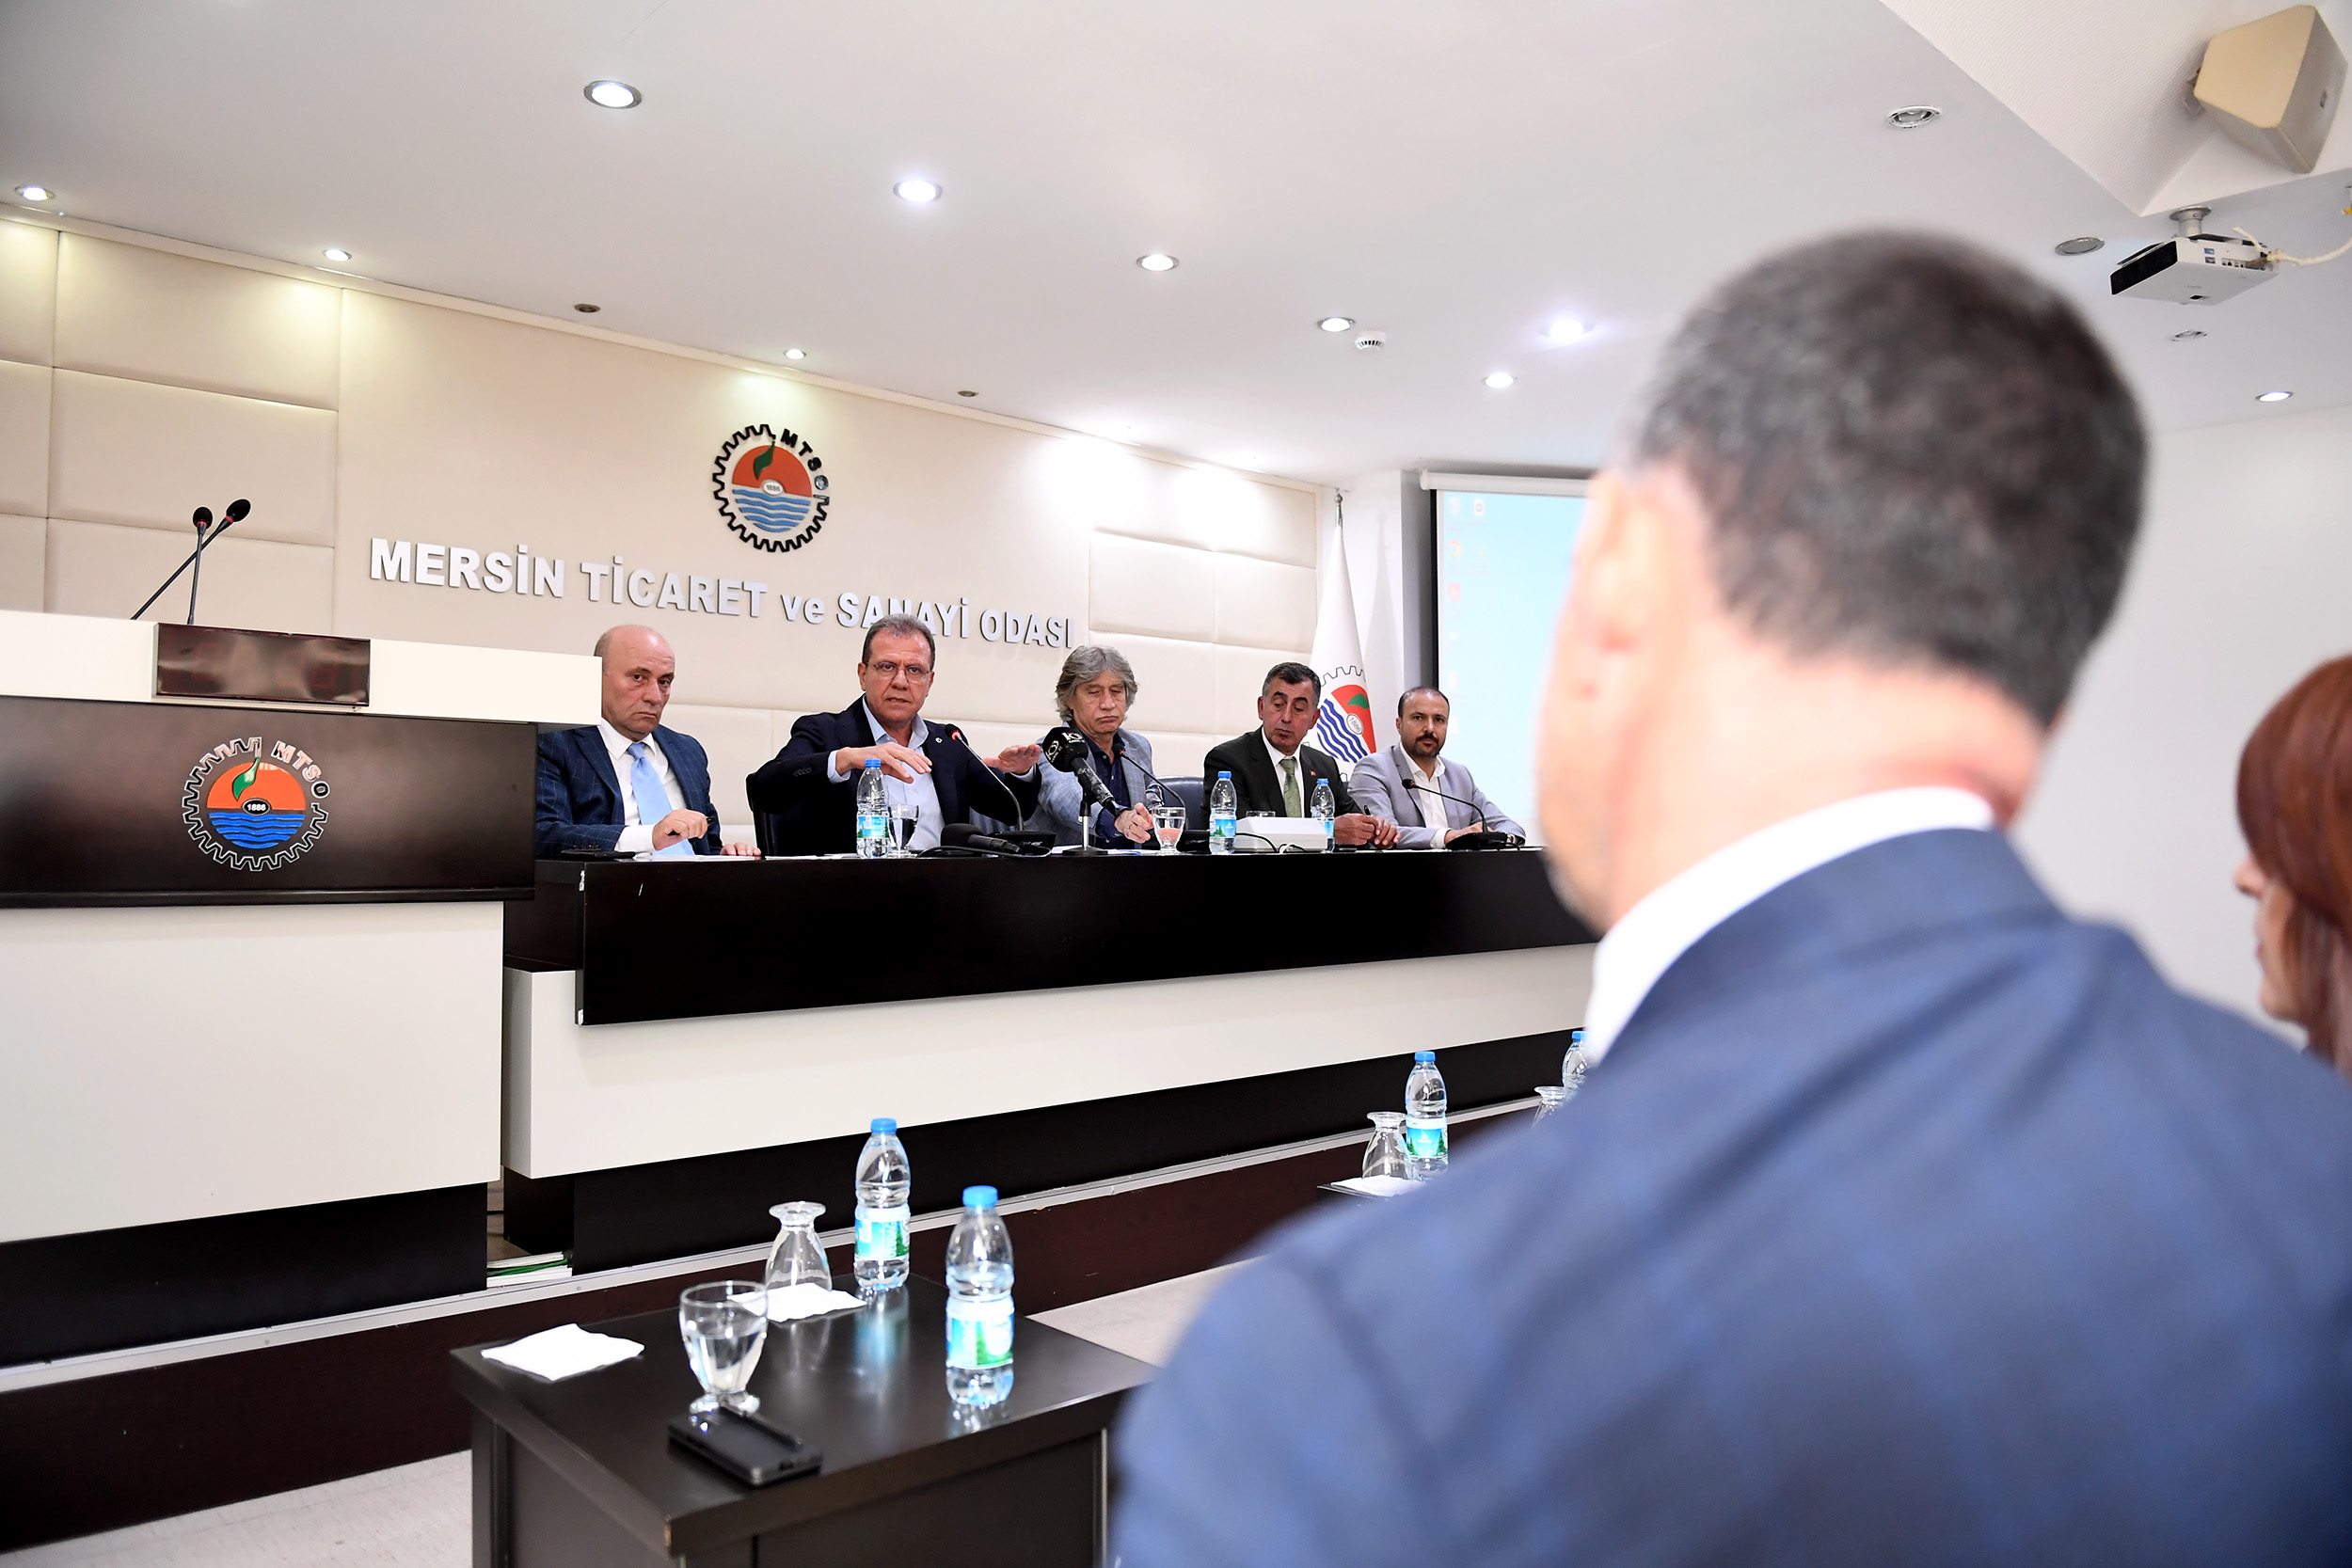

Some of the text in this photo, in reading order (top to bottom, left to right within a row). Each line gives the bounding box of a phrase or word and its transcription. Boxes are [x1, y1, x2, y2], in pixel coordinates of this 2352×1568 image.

[370, 537, 564, 598] MERSİN
[580, 555, 768, 617] TİCARET
[781, 594, 826, 624] ve
[980, 609, 1073, 648] ODASI
[271, 740, 330, 799] MTSO
